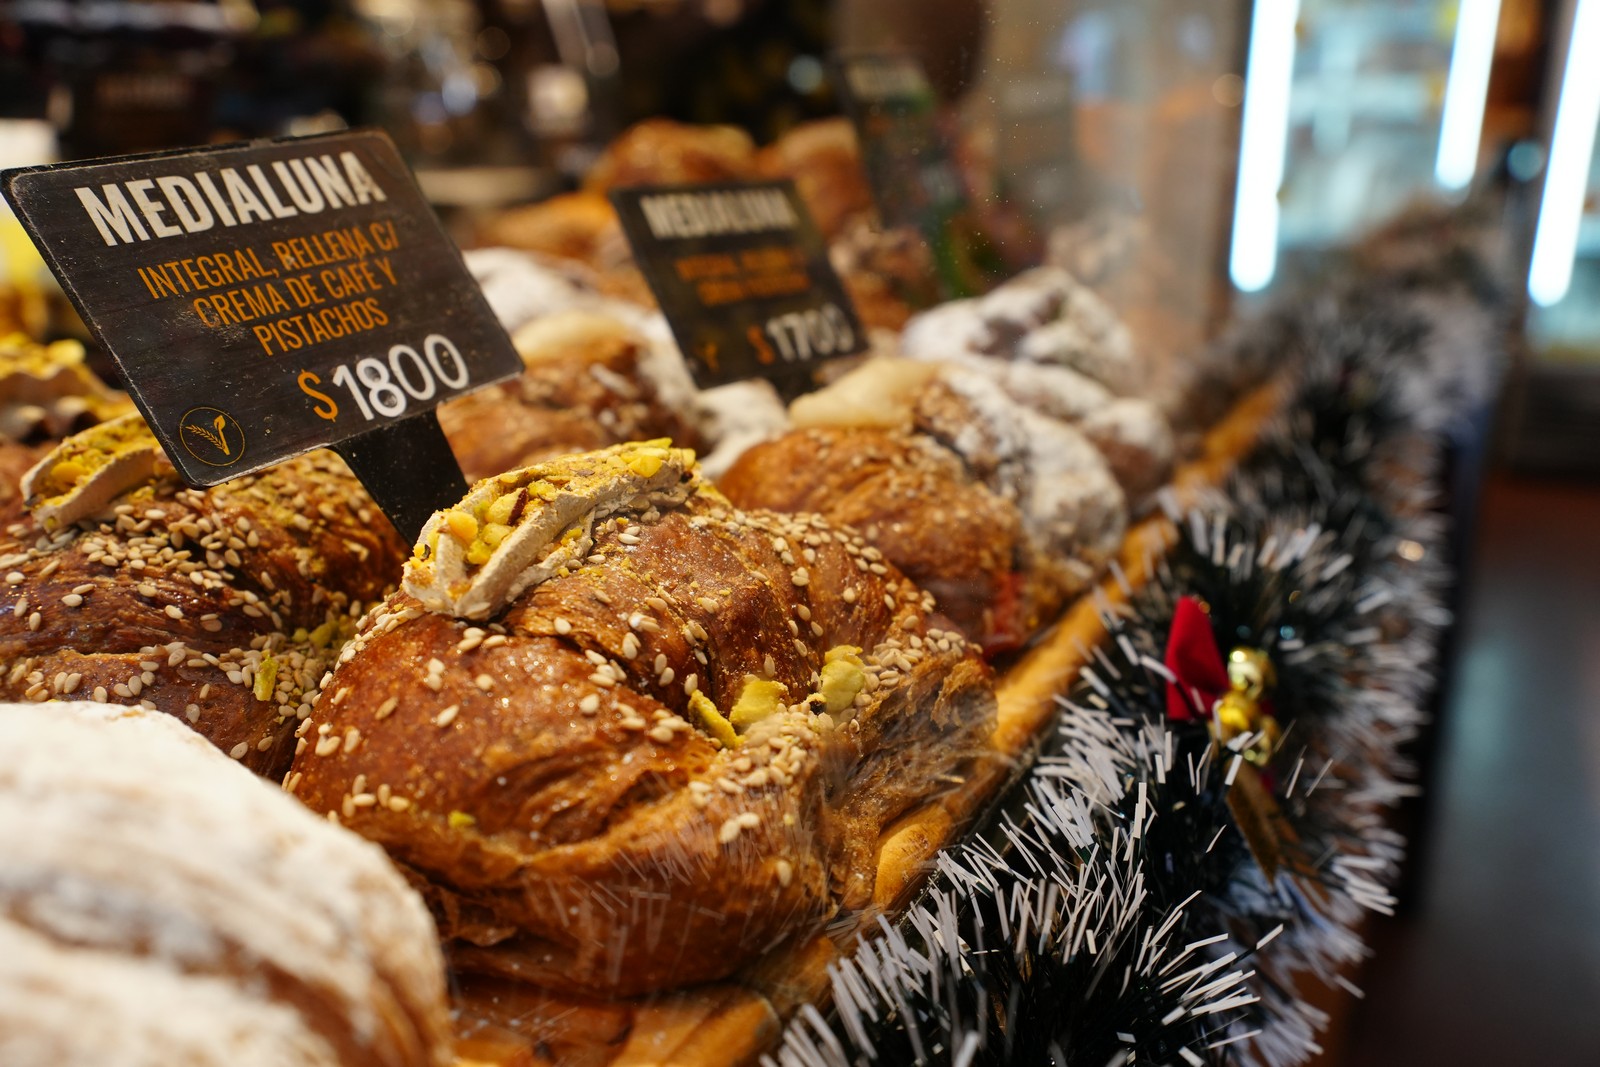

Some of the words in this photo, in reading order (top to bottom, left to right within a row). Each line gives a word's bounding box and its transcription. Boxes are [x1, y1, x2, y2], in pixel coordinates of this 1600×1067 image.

[75, 151, 387, 247] MEDIALUNA
[137, 247, 280, 299] INTEGRAL,
[271, 226, 376, 271] RELLENA
[192, 281, 291, 329] CREMA
[284, 274, 326, 308] DE
[374, 255, 398, 286] Y
[252, 297, 389, 357] PISTACHOS
